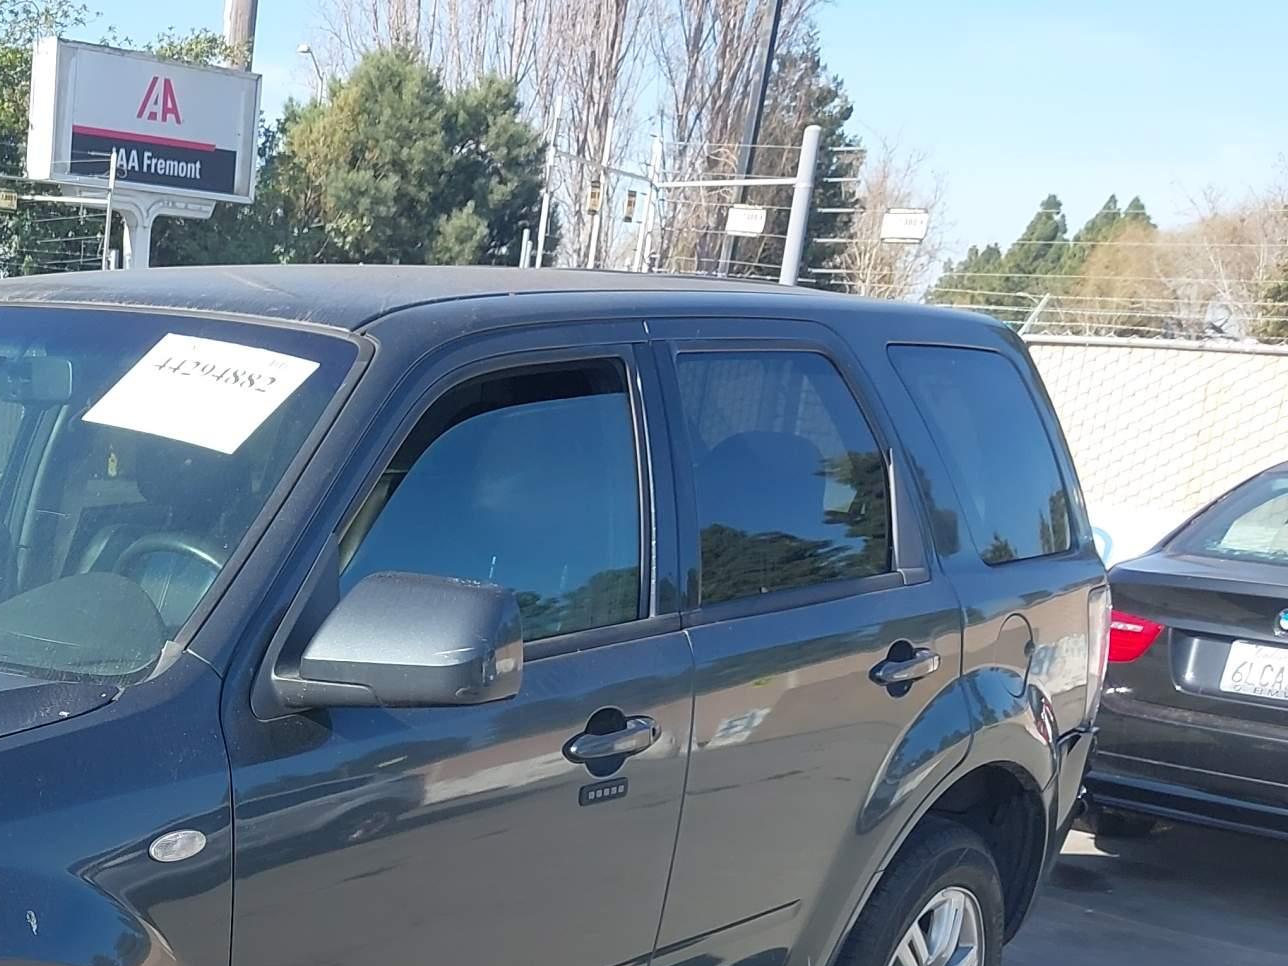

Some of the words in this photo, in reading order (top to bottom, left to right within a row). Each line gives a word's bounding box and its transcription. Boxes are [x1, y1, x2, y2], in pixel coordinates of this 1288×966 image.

[112, 147, 139, 172] AA
[143, 151, 201, 179] Fremont
[152, 357, 277, 393] 44294882
[1231, 660, 1288, 692] 6LCA
